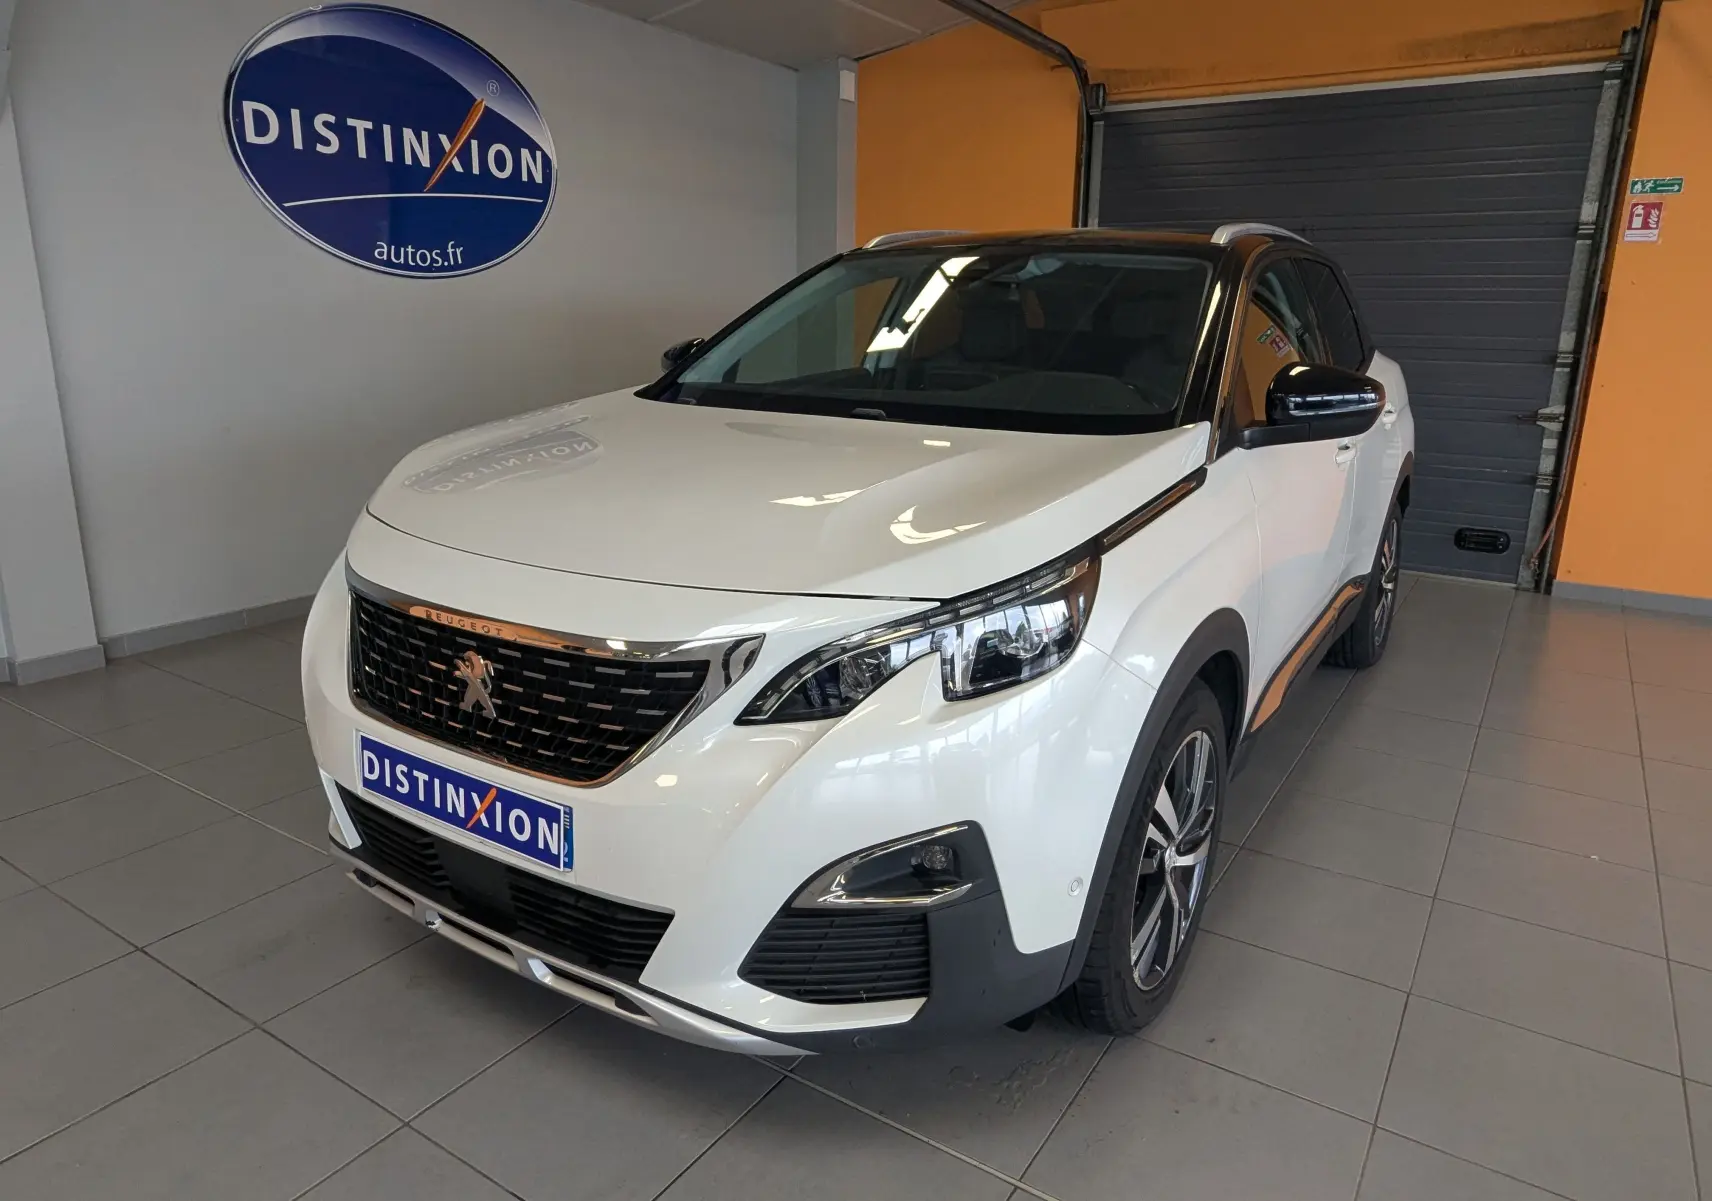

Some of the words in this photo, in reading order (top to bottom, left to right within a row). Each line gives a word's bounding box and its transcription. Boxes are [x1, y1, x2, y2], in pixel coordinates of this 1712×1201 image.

[242, 98, 543, 190] DISTINXION
[374, 241, 464, 267] autos.fr
[425, 609, 503, 636] PEUGEOT
[363, 749, 558, 855] DISTINXION
